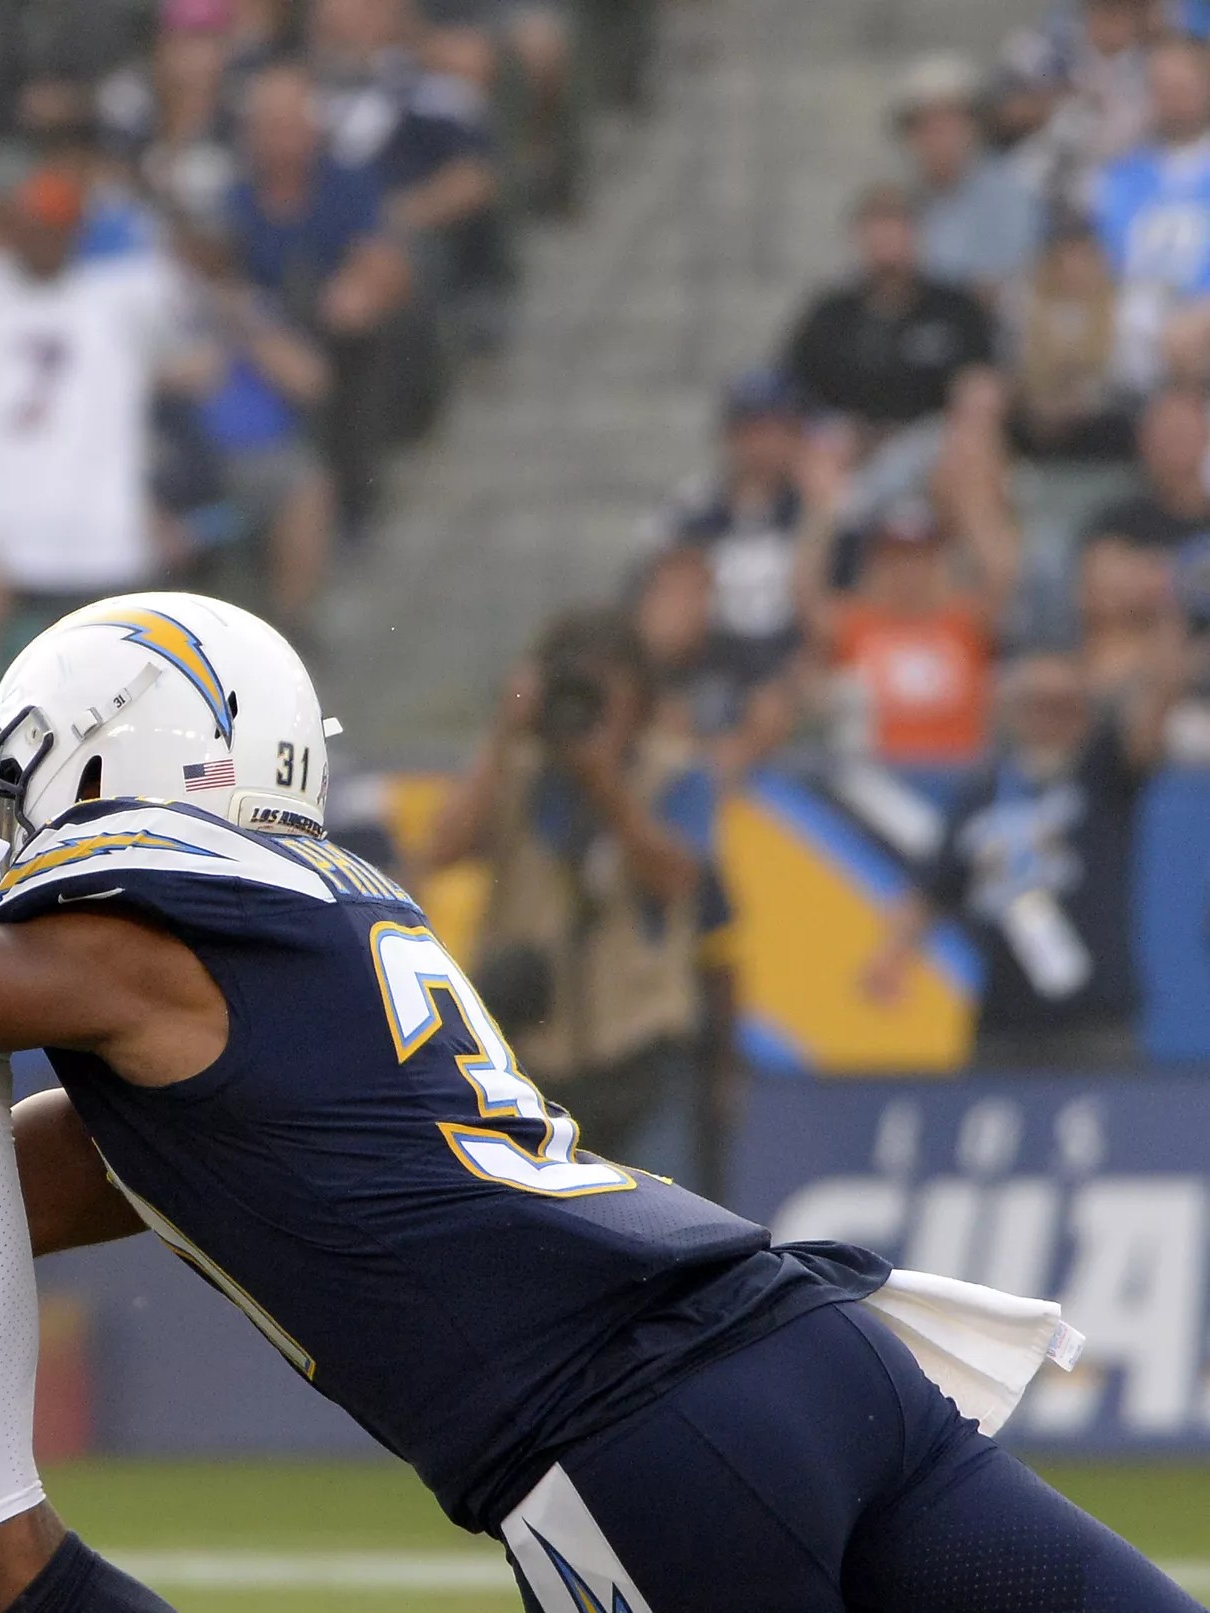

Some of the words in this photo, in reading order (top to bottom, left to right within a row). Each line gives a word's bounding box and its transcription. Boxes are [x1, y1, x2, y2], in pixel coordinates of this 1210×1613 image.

[113, 694, 126, 709] 31
[276, 740, 309, 793] 31
[250, 808, 280, 824] LOS
[369, 920, 673, 1199] 3
